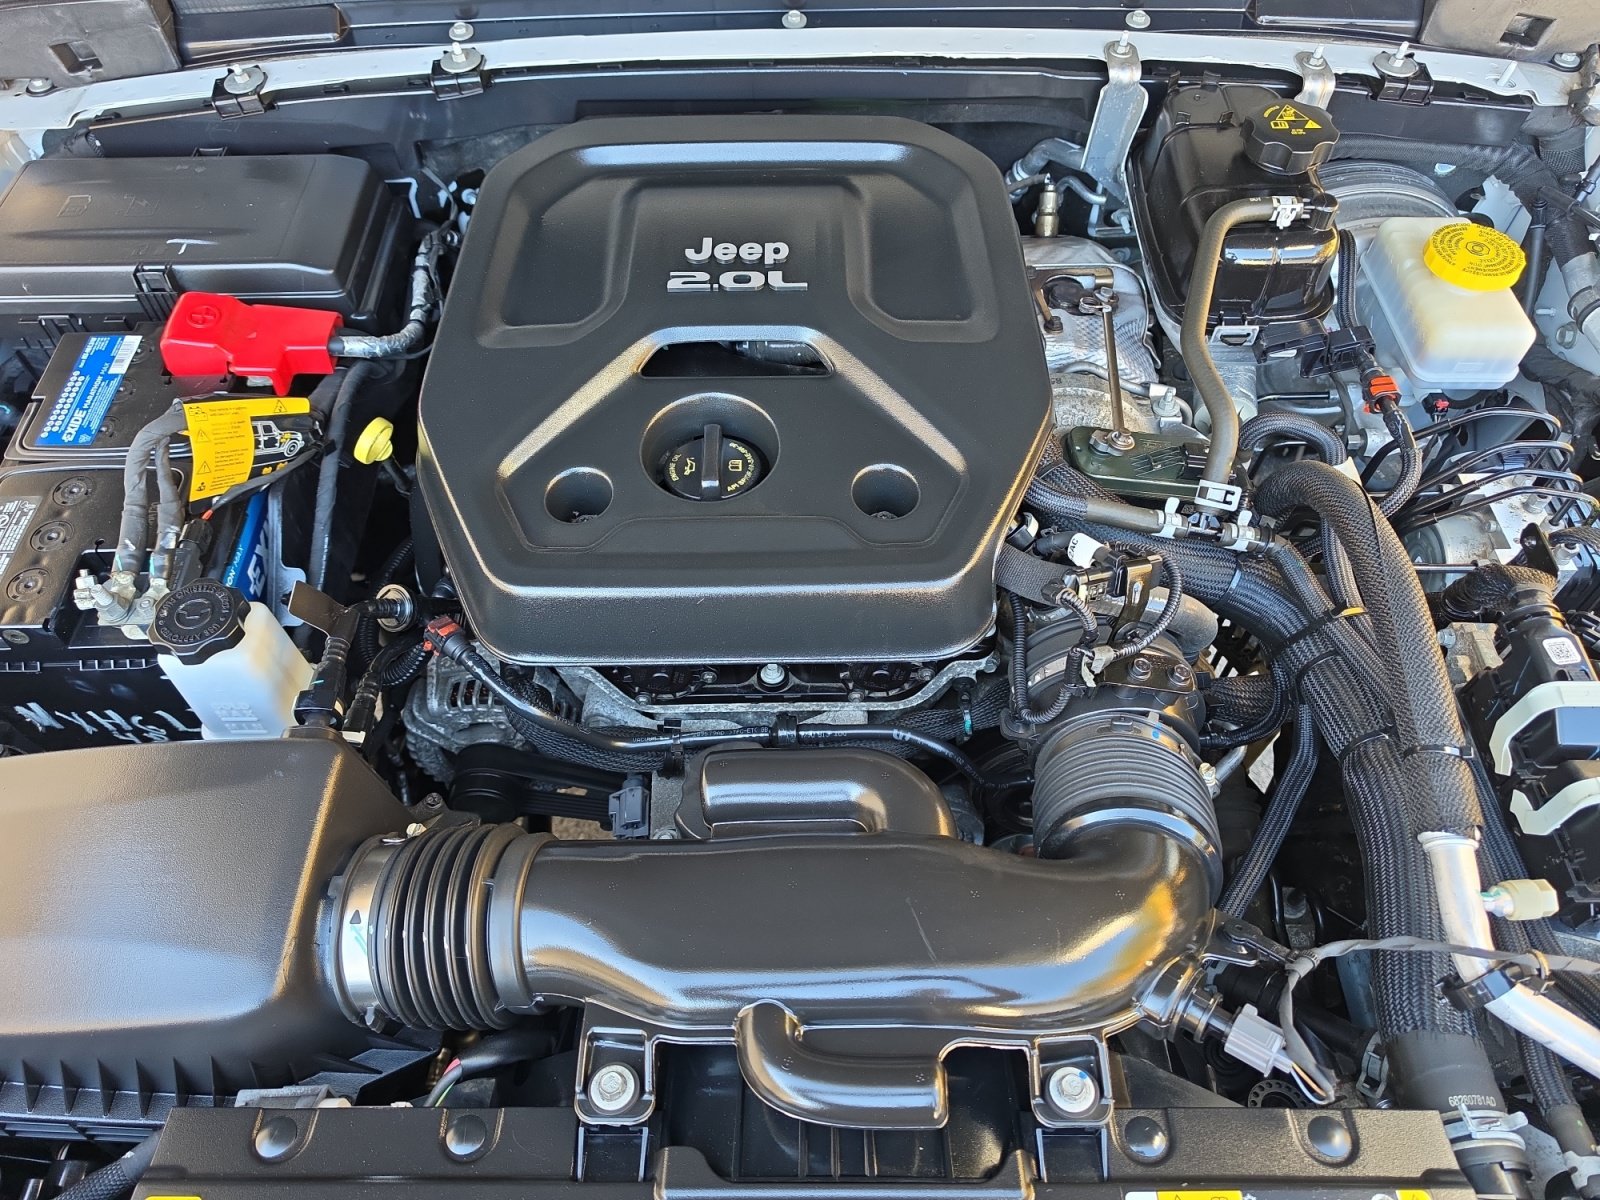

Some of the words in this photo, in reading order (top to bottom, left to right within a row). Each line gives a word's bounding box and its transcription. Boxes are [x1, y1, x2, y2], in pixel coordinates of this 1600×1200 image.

[685, 237, 789, 267] Jeep
[667, 271, 808, 292] 2.0L
[62, 407, 87, 442] EXIDE
[83, 375, 103, 409] MARATHON
[669, 462, 679, 481] ENGINE
